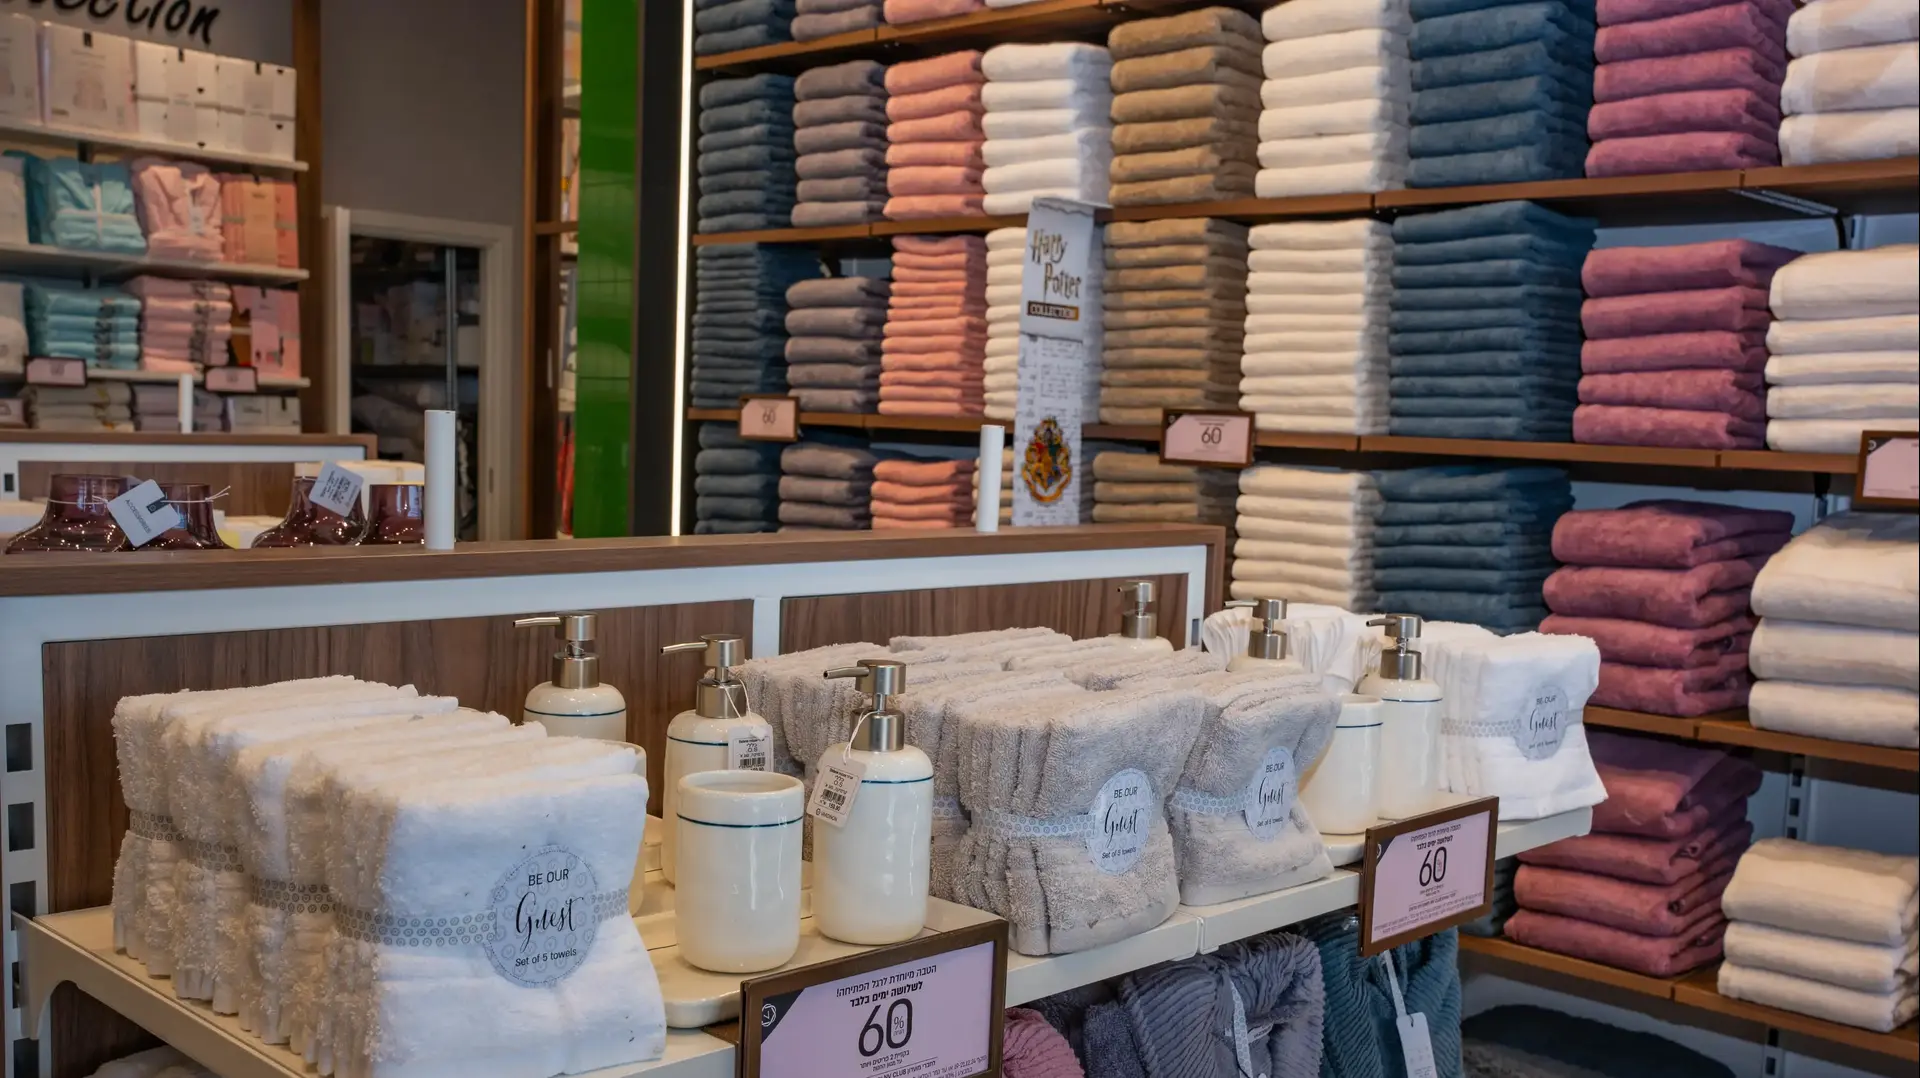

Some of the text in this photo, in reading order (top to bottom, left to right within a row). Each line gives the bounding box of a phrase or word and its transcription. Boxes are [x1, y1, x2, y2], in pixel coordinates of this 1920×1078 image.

[1029, 228, 1068, 265] Harry
[1044, 262, 1081, 302] Potter
[762, 408, 776, 425] 60
[1201, 427, 1222, 444] 60
[1265, 762, 1285, 773] BE OUR
[1113, 786, 1138, 799] BE OUR
[1259, 776, 1289, 817] Guest
[1104, 802, 1145, 848] Guest
[1101, 851, 1111, 859] Set
[1111, 849, 1117, 858] of
[1419, 846, 1447, 887] 60
[528, 868, 569, 886] BE OUR
[515, 891, 584, 953] Guest
[515, 947, 577, 967] Set of 5 towels
[836, 965, 937, 997] הטבה מיוחדת לרגל הפתיחה!
[849, 981, 923, 1007] לשלושה ימים בלבד
[858, 998, 913, 1057] 60
